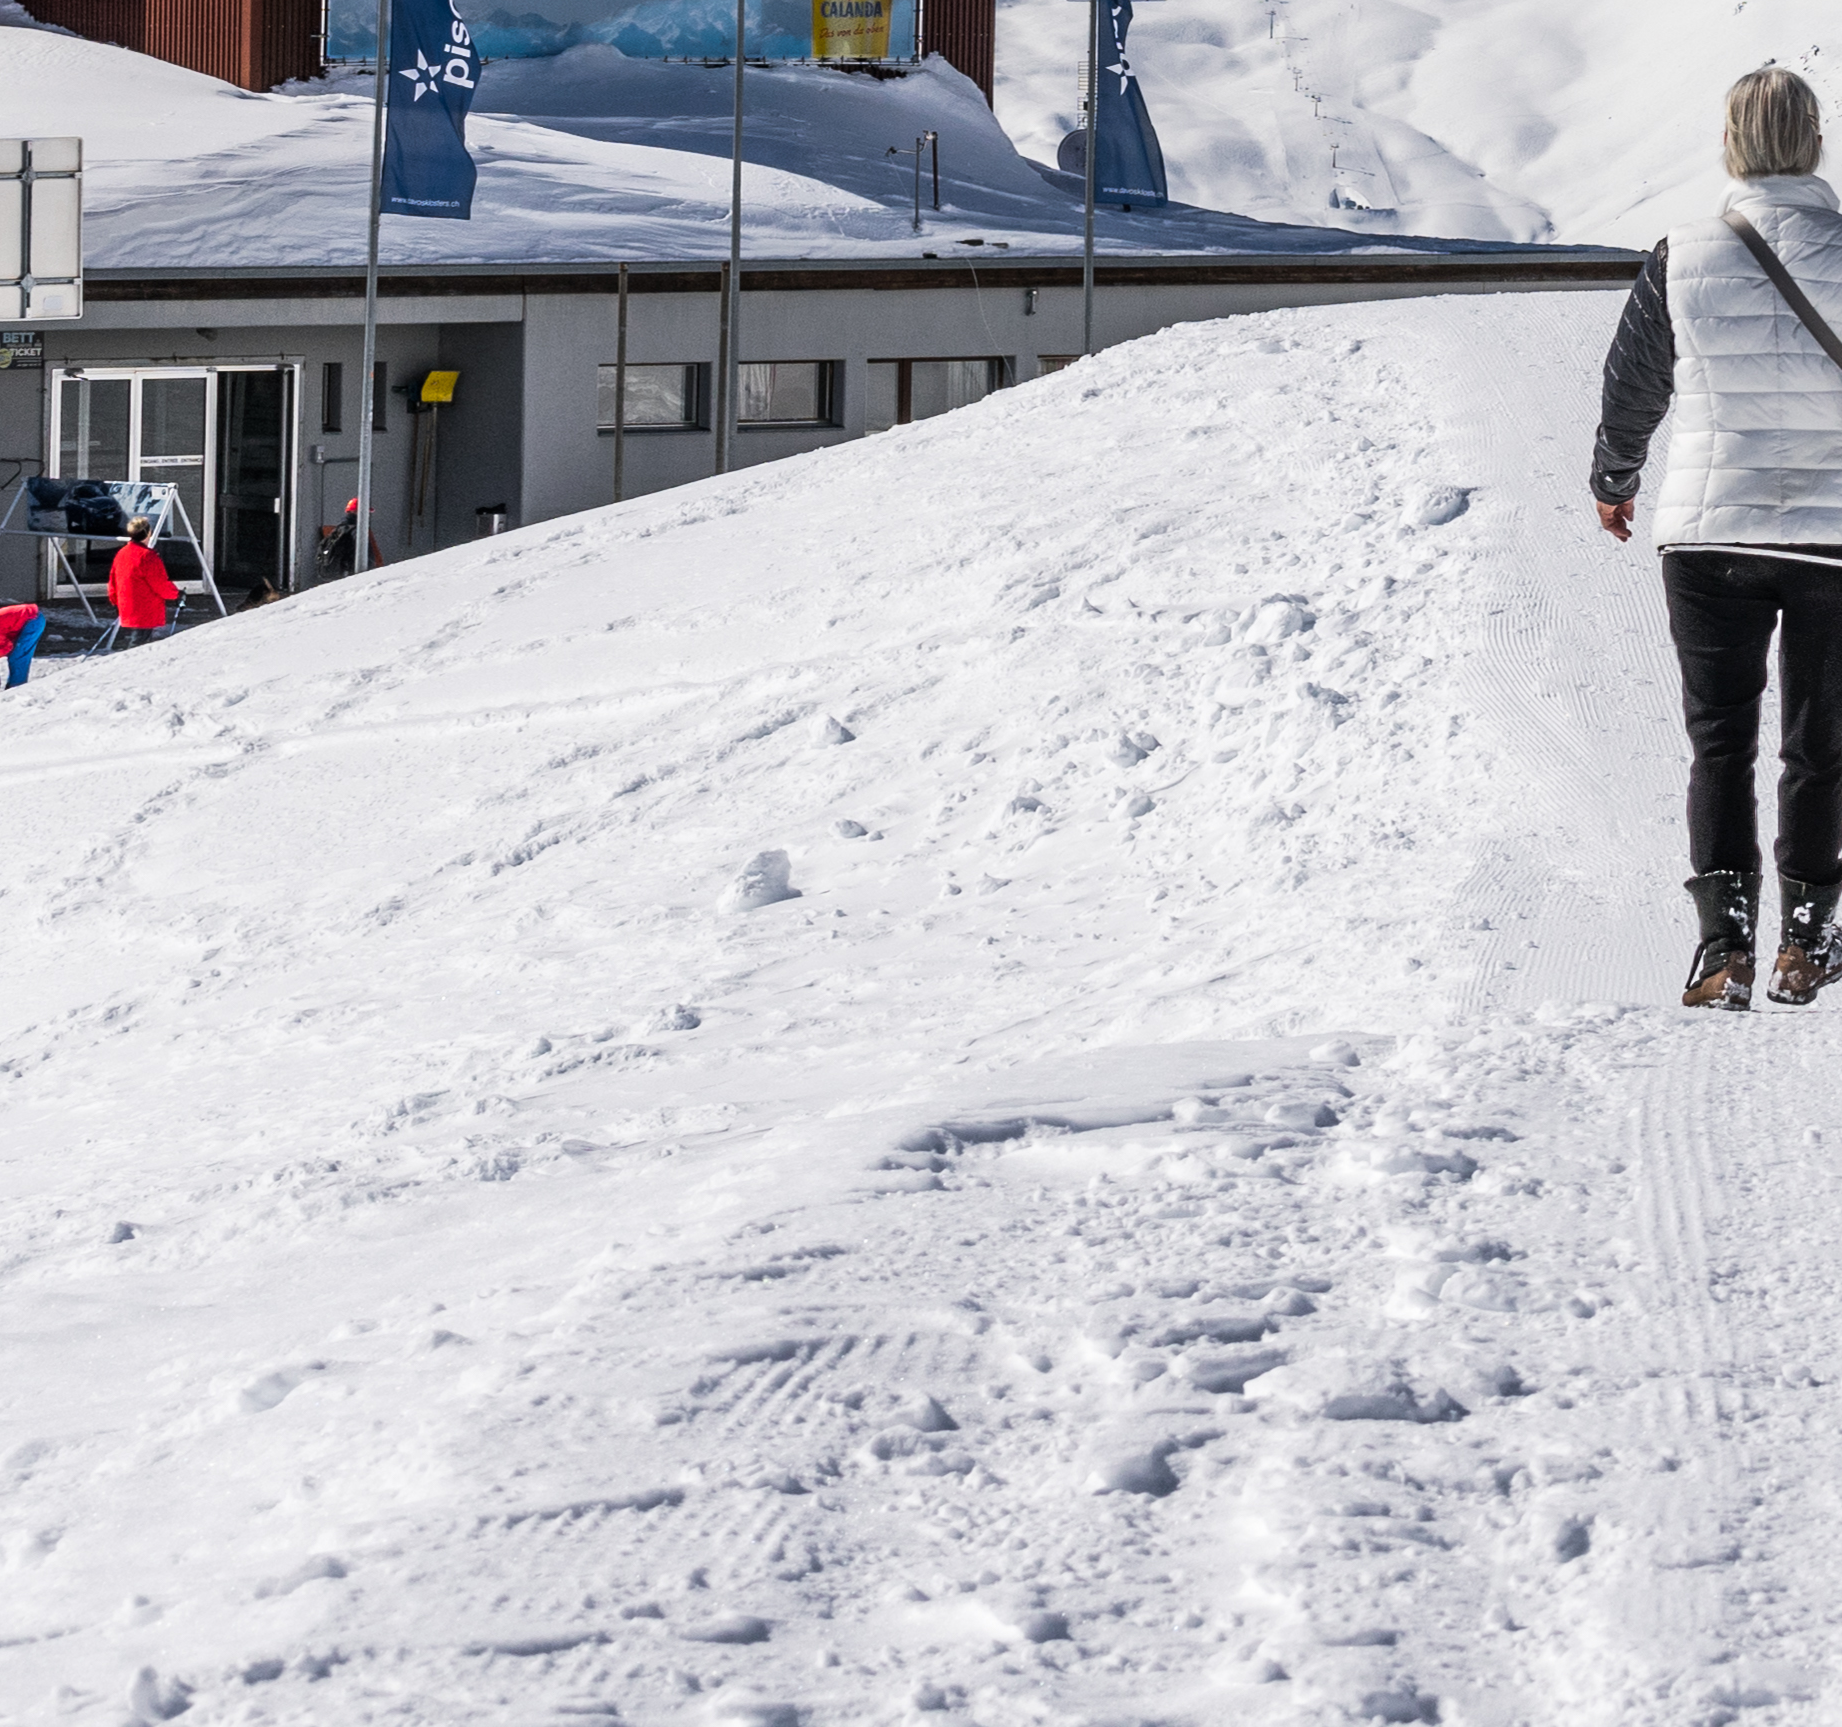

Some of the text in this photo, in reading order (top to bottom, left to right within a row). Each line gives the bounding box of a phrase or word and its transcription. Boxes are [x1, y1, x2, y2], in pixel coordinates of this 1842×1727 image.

[821, 1, 882, 17] CALANDA
[3, 332, 35, 343] BETT
[8, 347, 42, 356] TICKET
